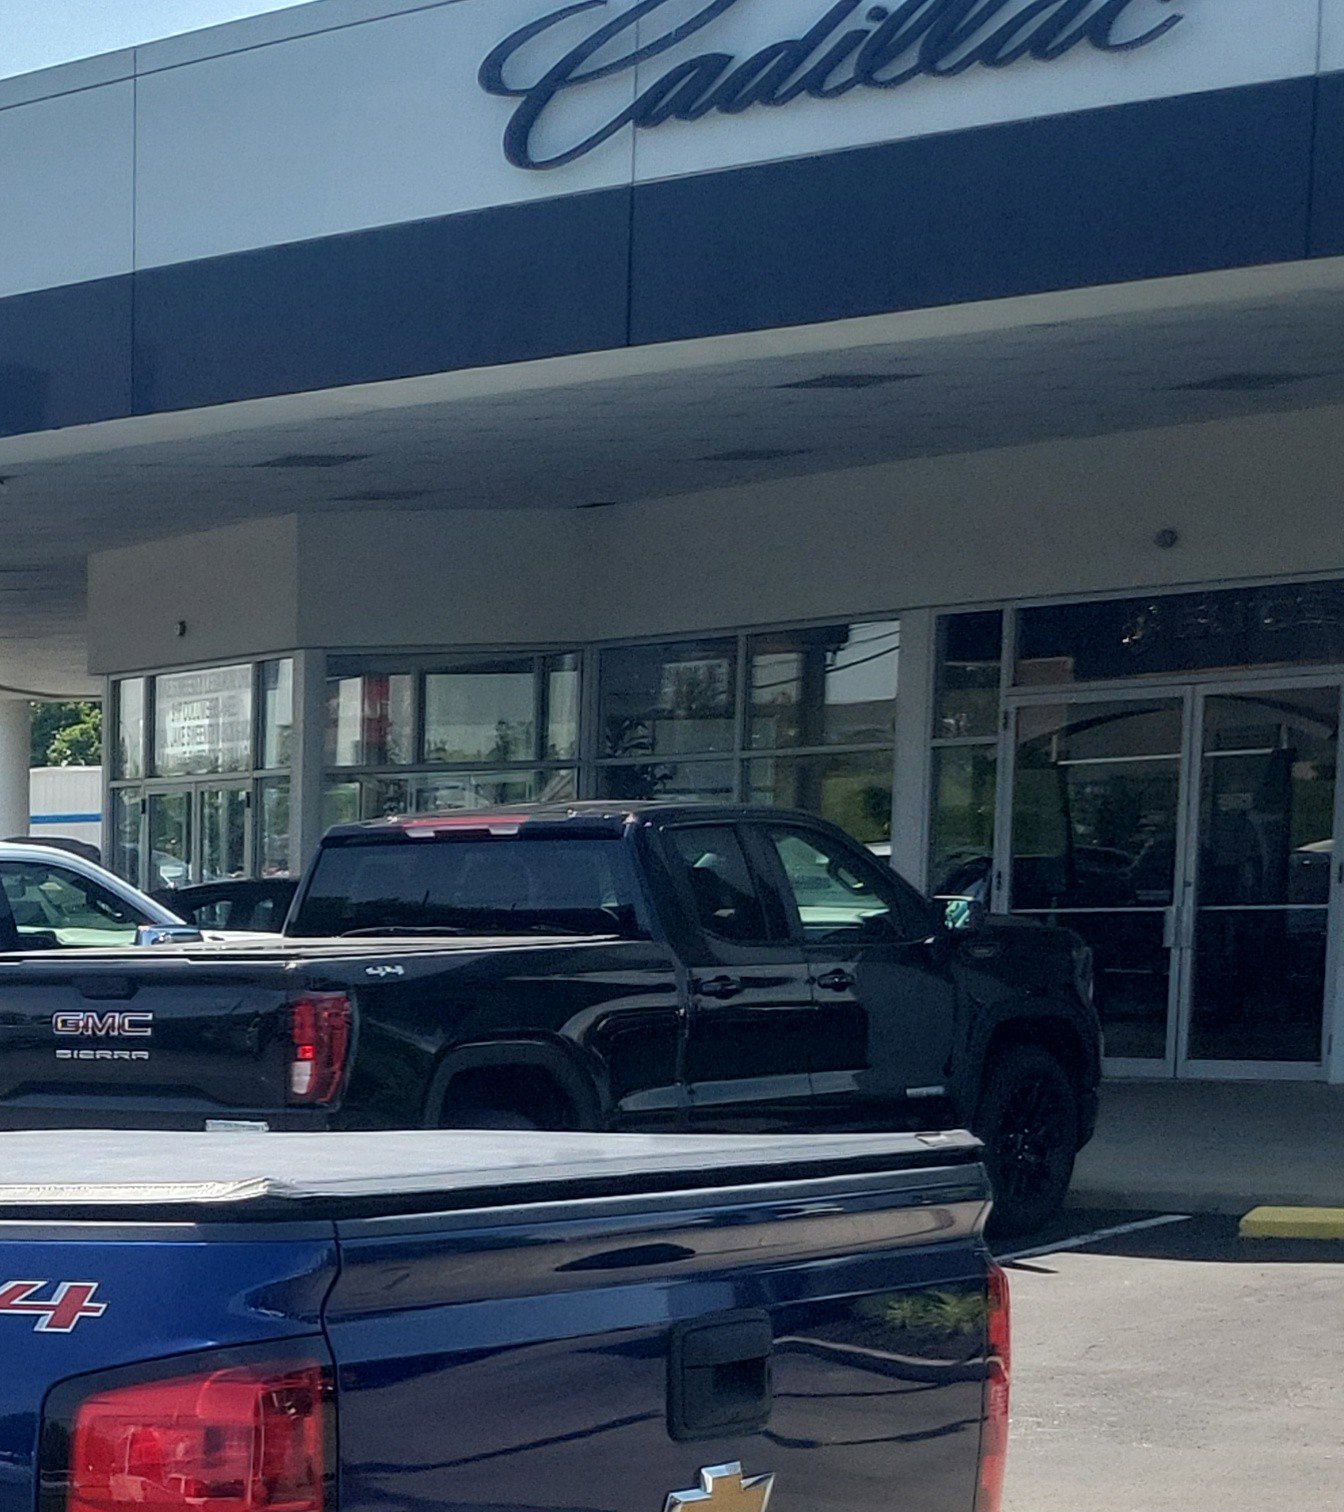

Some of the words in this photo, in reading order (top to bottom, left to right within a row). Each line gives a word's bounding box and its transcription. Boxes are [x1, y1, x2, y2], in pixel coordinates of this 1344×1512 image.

[478, 0, 1183, 170] Cadillac
[52, 1011, 153, 1036] GMC
[55, 1049, 149, 1060] SIERRA
